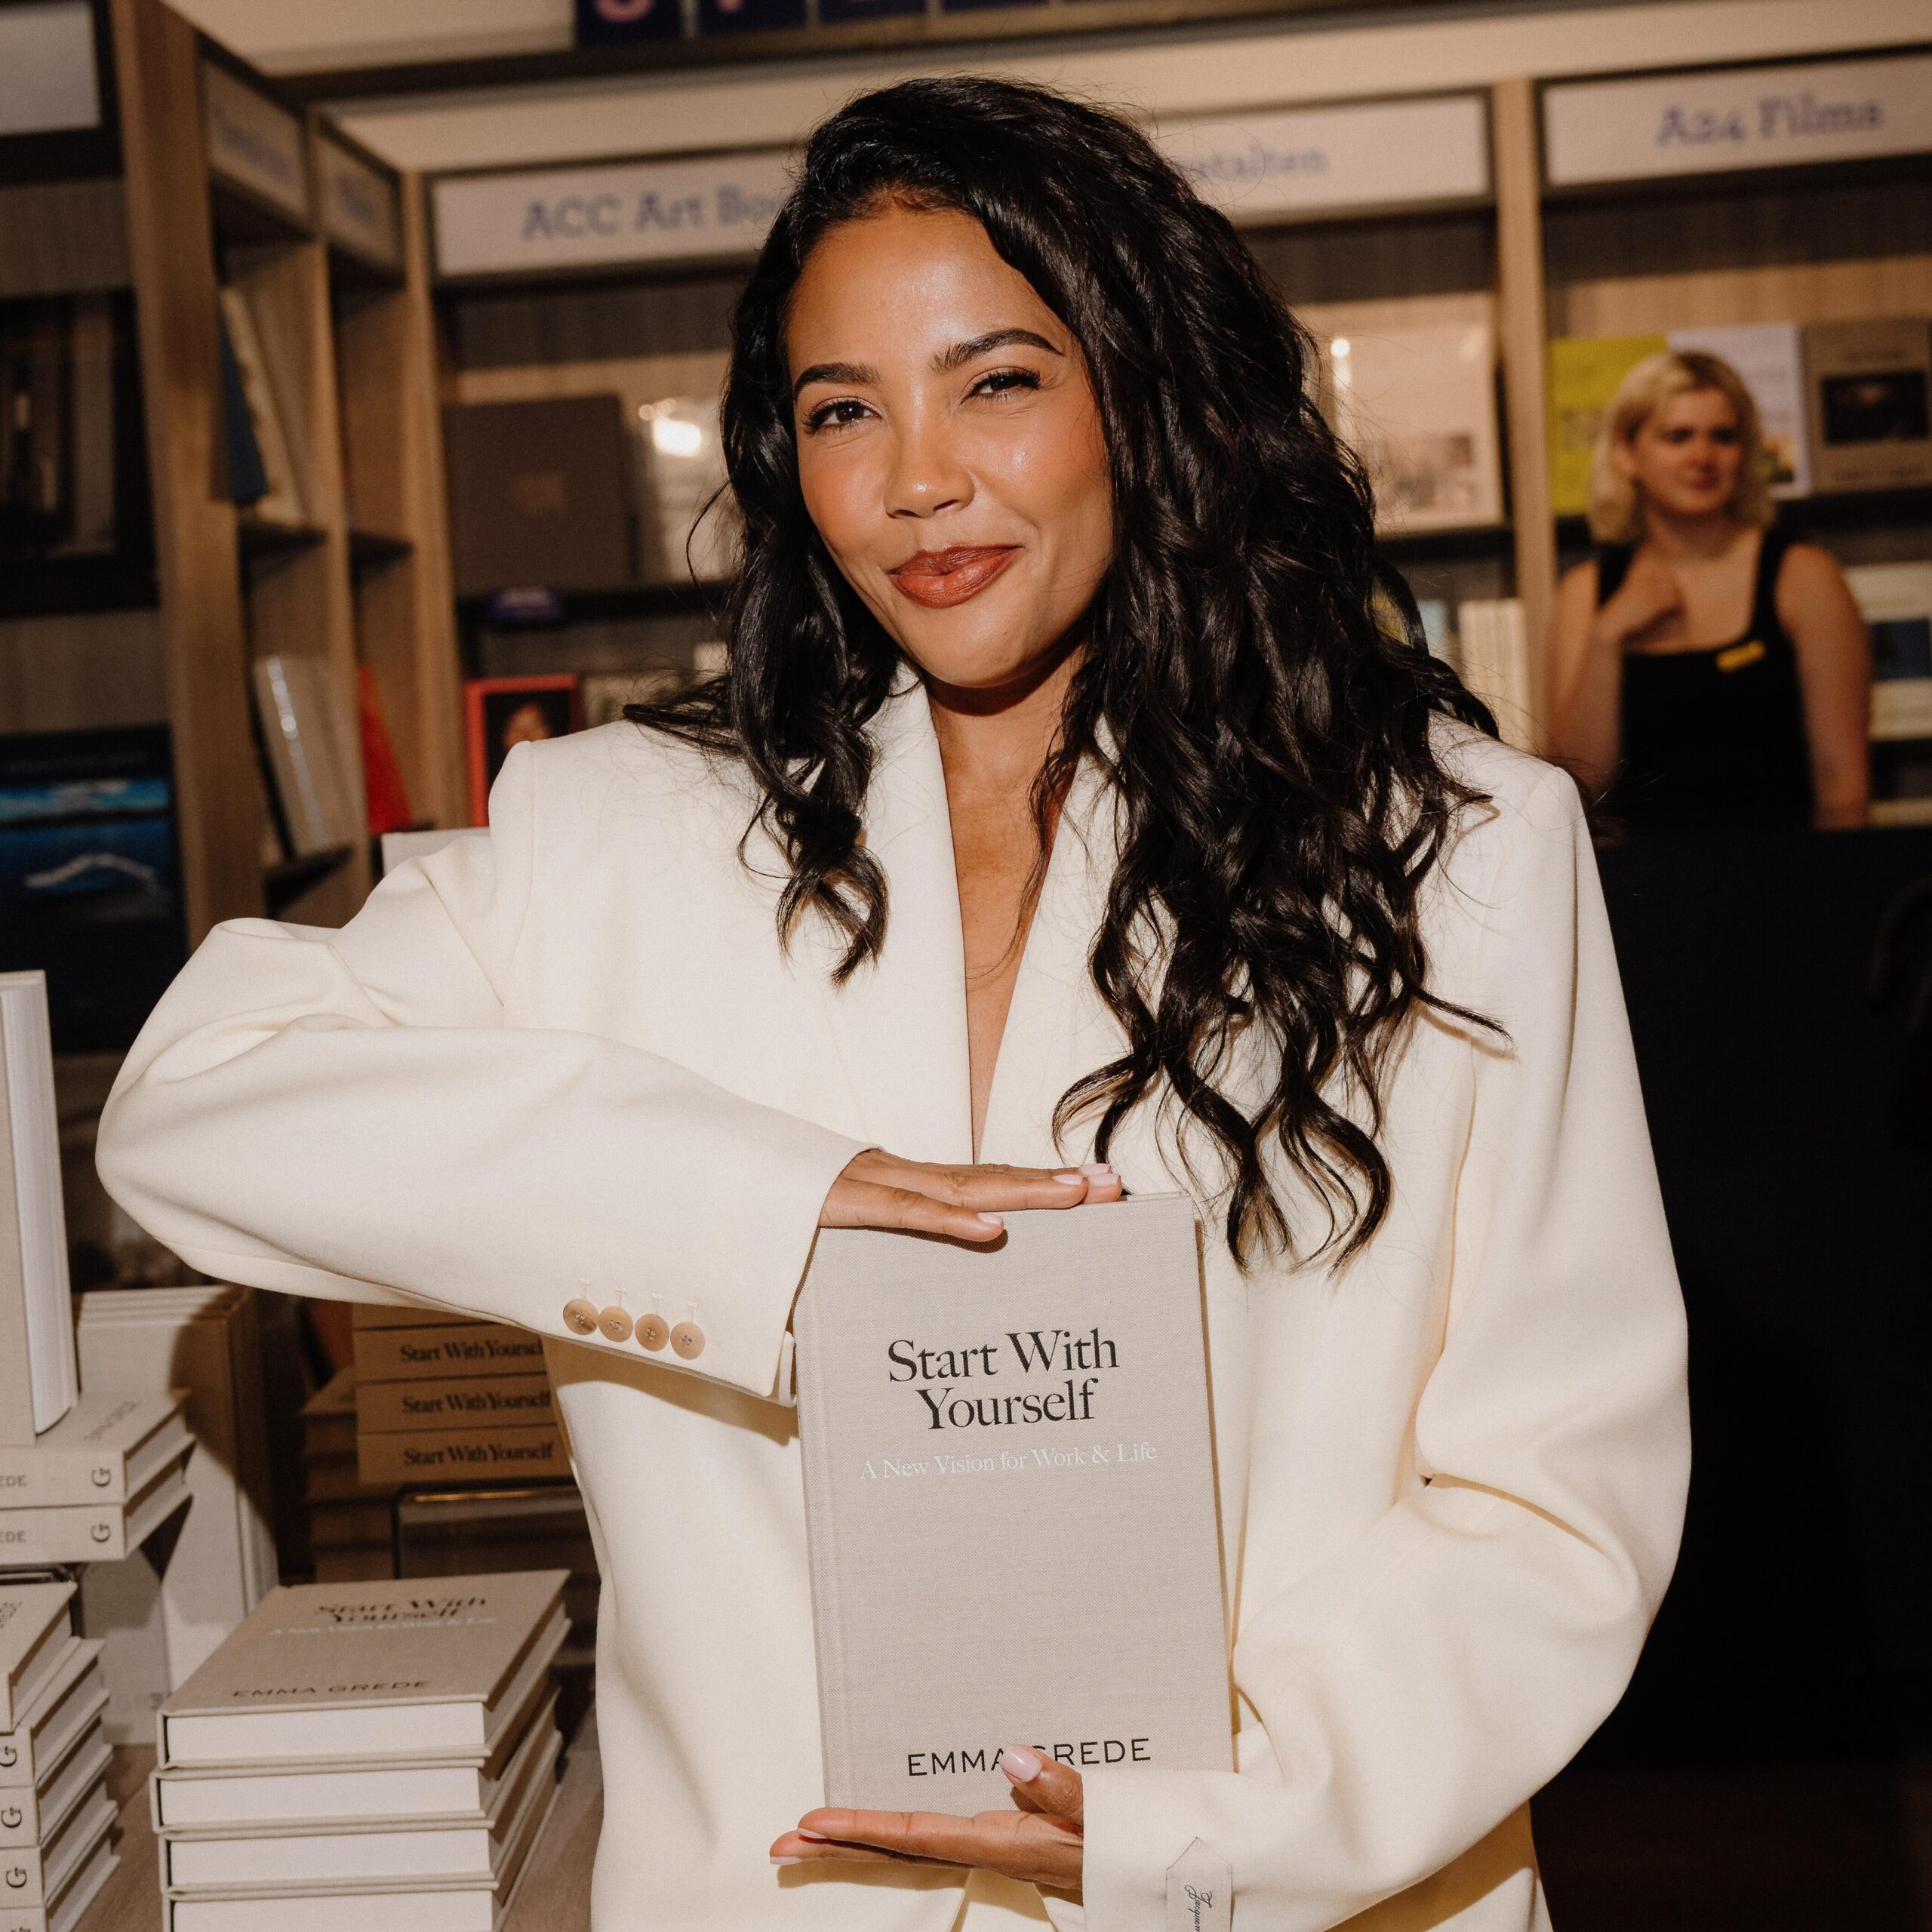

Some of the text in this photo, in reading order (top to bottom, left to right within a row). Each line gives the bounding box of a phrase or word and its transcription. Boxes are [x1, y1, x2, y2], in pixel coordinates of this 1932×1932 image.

[400, 1337, 543, 1361] Start With Yoursel
[888, 1327, 1120, 1383] Start With
[401, 1396, 442, 1414] Start
[445, 1393, 487, 1411] With
[915, 1378, 1099, 1430] Yourself
[403, 1441, 555, 1466] Start With Yourself
[860, 1441, 1157, 1480] A New Vision for Work & Life
[232, 1680, 433, 1698] EMMA GREDE
[1032, 1738, 1151, 1765] REDE
